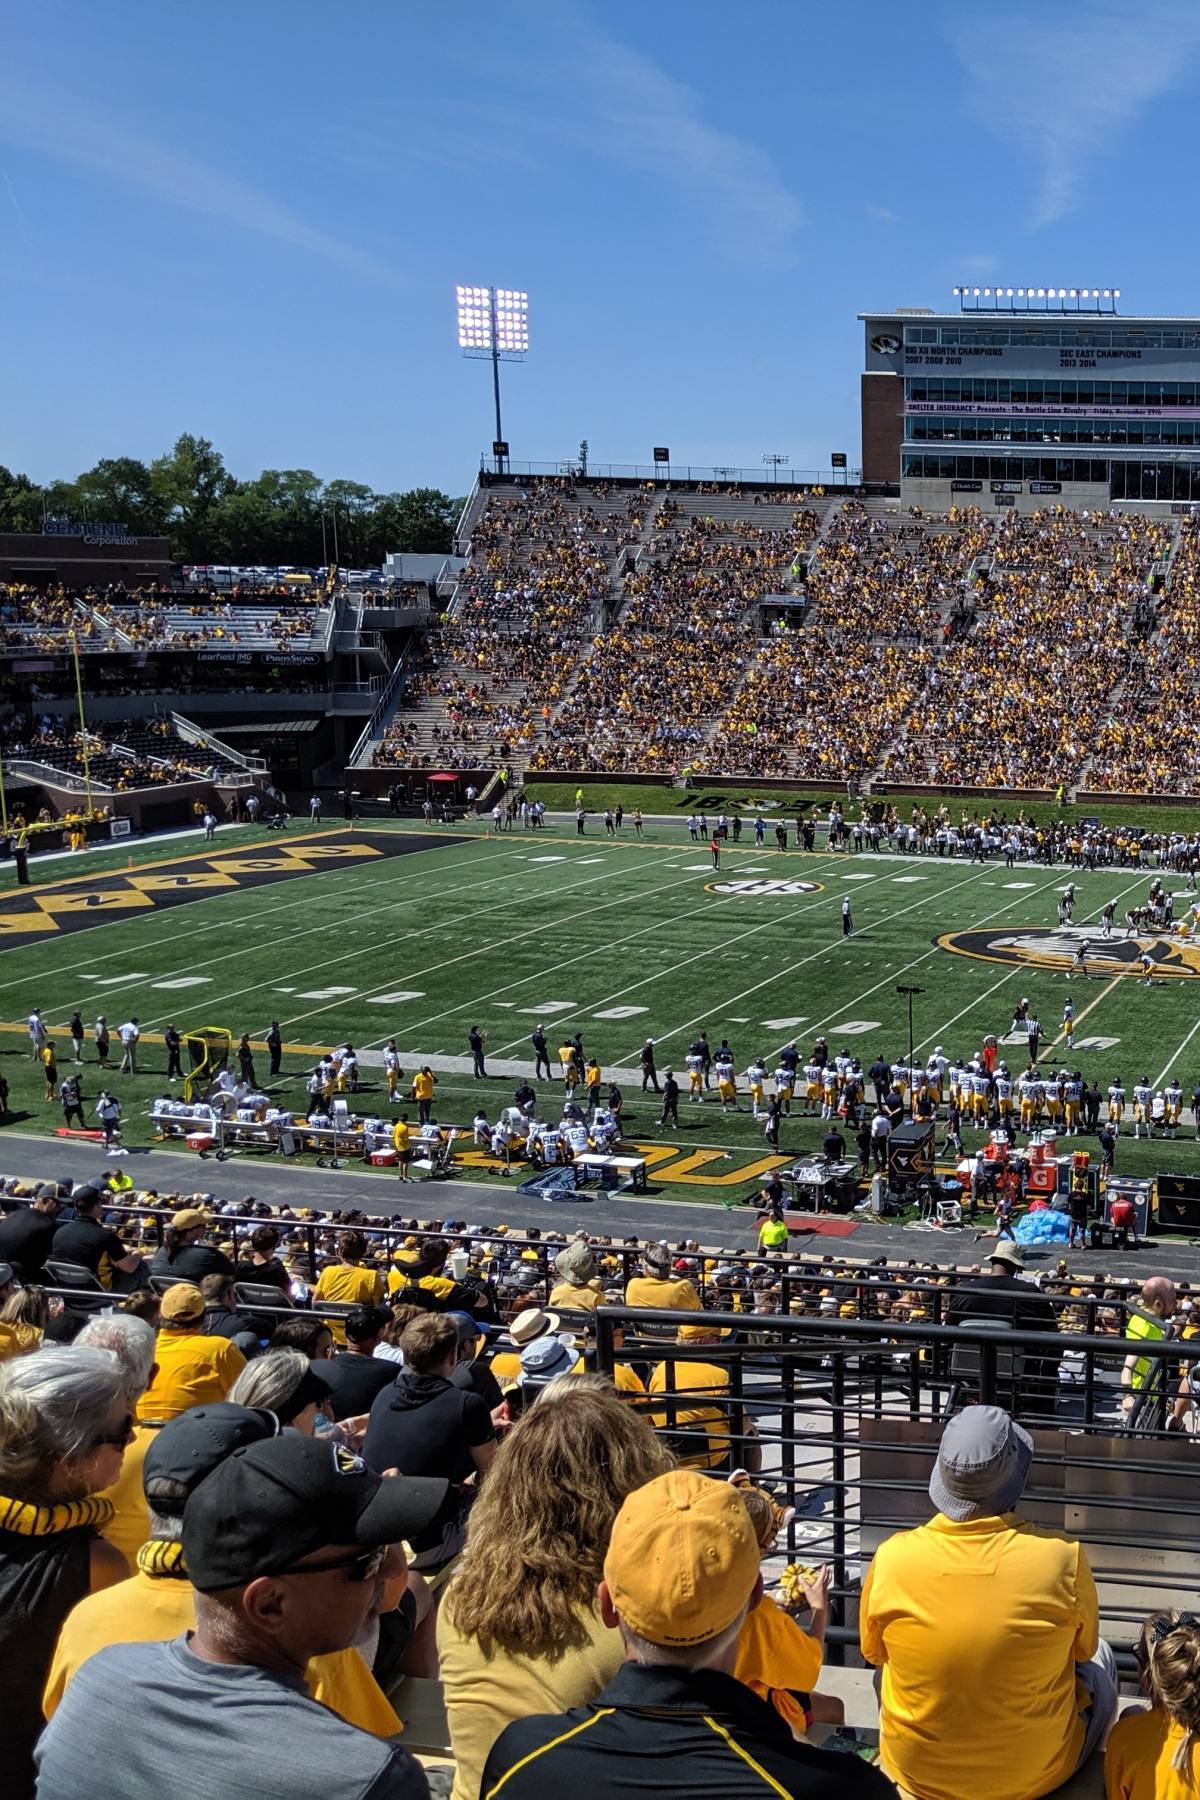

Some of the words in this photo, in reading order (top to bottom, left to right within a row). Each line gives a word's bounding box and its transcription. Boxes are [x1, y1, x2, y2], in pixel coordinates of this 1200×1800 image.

[930, 347, 956, 355] NORTH
[958, 348, 1004, 356] CHAMPIONS
[1059, 350, 1074, 358] SEC
[1075, 350, 1095, 358] EAST
[1096, 350, 1142, 359] CHAMPIONS
[1059, 359, 1077, 367] 2013
[1079, 359, 1097, 367] 2014
[908, 403, 935, 412] SHELTER
[43, 521, 128, 536] CENTENE
[83, 535, 138, 547] Corporation
[197, 652, 236, 661] Learfield
[237, 652, 253, 661] IMG
[1032, 1170, 1049, 1186] G
